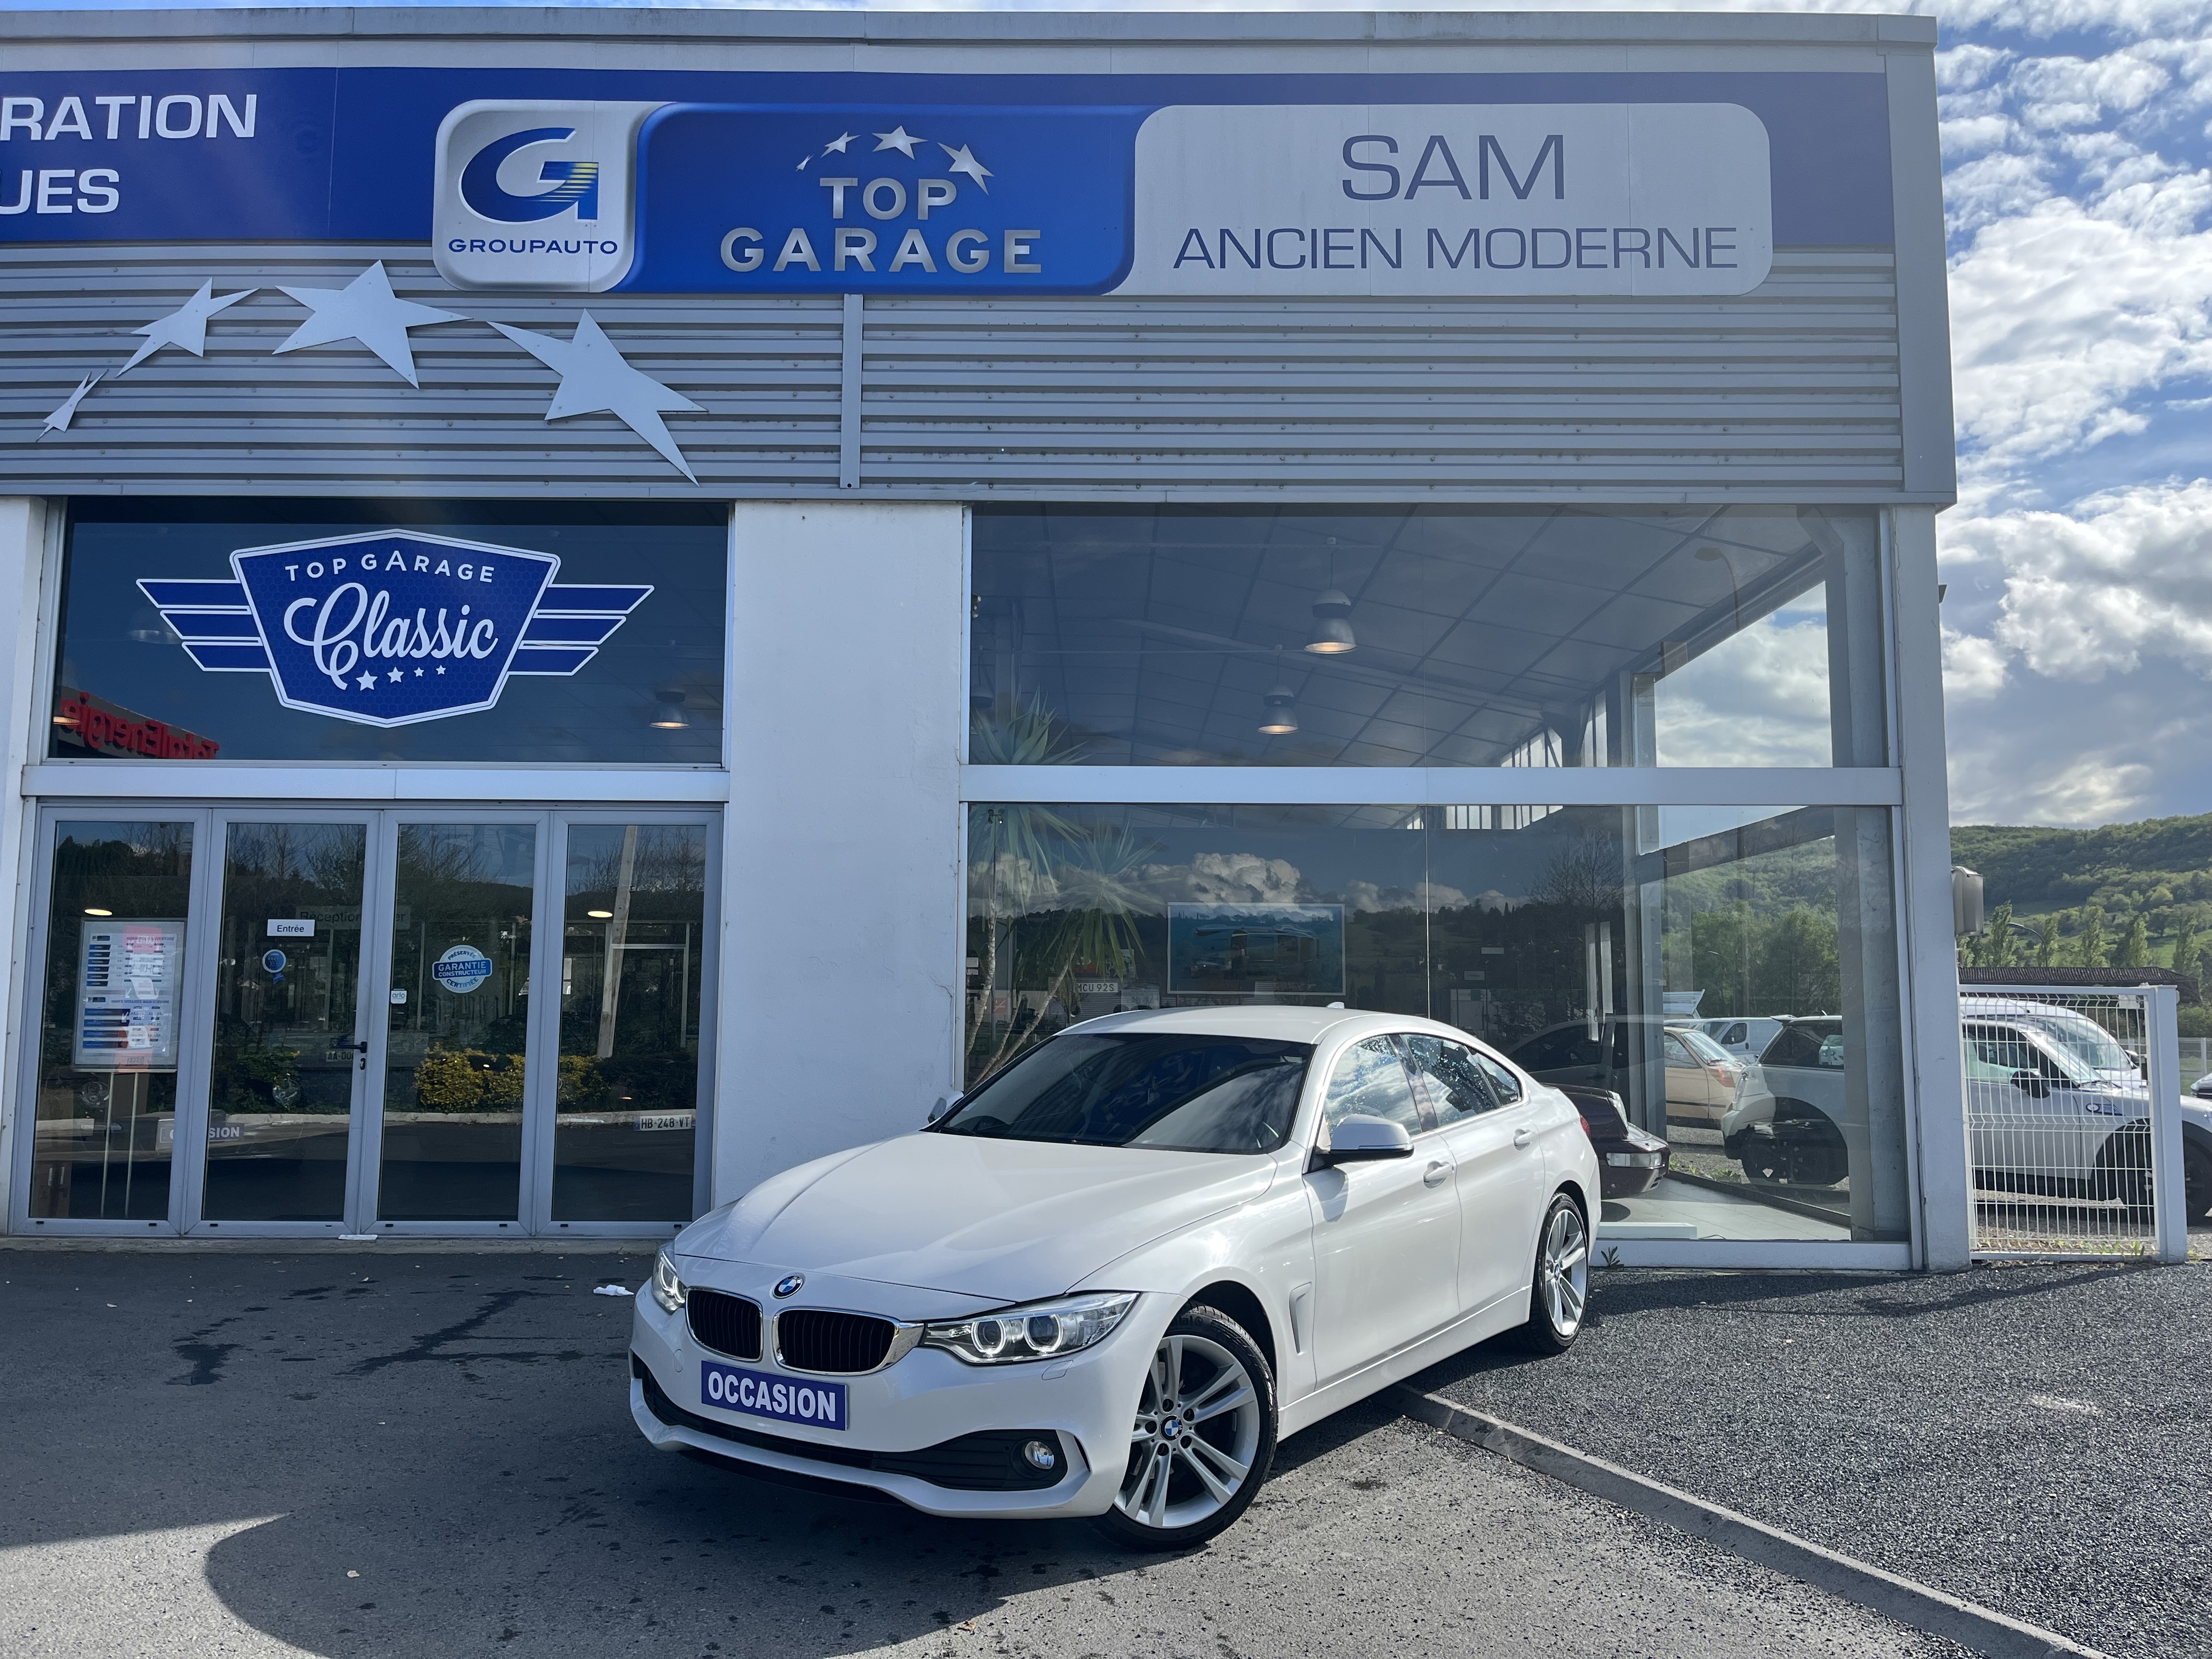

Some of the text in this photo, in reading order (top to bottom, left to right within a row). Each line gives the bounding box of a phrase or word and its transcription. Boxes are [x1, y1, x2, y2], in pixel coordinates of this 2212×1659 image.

[1341, 134, 1565, 201] SAM
[820, 177, 957, 220] TOP
[448, 239, 618, 254] GROUPAUTO
[720, 227, 1041, 273] GARAGE
[1173, 227, 1738, 270] ANCIEN MODERNE
[285, 550, 494, 583] TOP GARAGE
[284, 582, 498, 690] Classic
[438, 961, 486, 971] GARANTIE
[448, 951, 476, 960] PRÉSERVÉE
[447, 977, 479, 988] CERTIFIÉE
[708, 1371, 836, 1421] OCCASION
